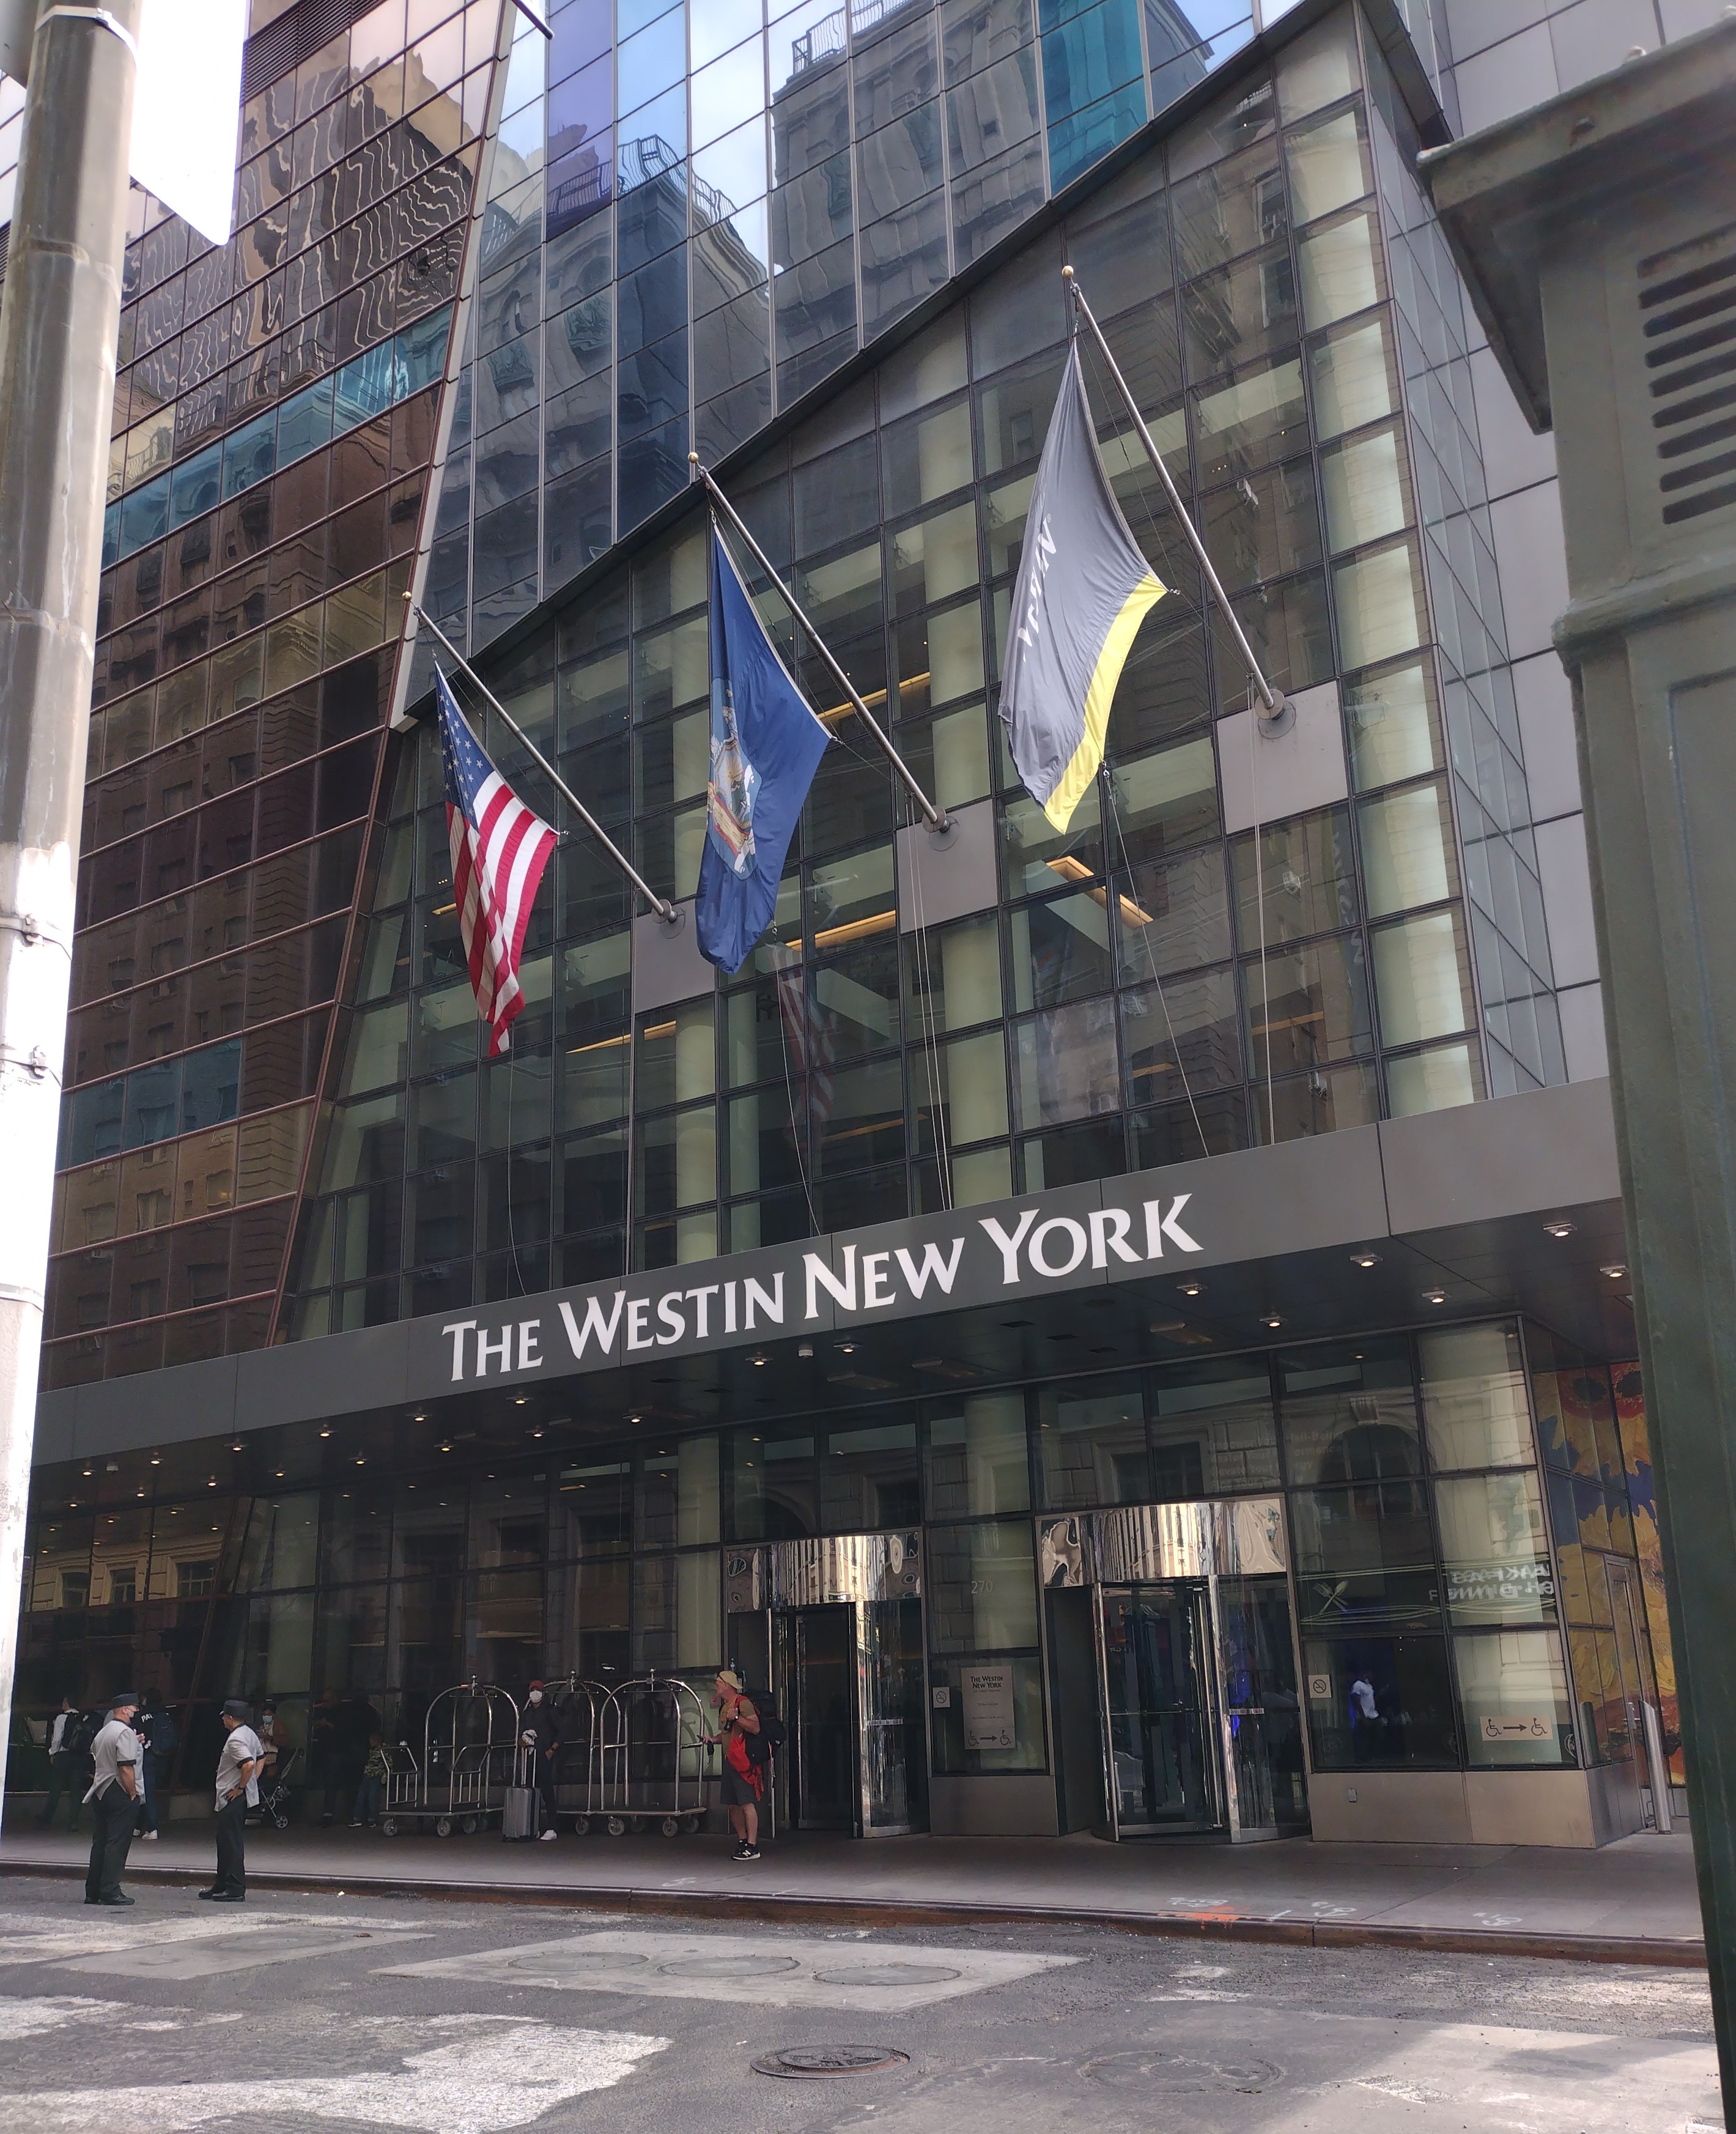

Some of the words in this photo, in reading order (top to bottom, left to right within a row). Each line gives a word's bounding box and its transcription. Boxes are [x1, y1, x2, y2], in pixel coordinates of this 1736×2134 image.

[441, 1319, 544, 1382] THE
[558, 1272, 785, 1360] WESTIN
[802, 1237, 966, 1319] NEW
[978, 1193, 1205, 1284] YORK
[971, 1580, 993, 1594] 270
